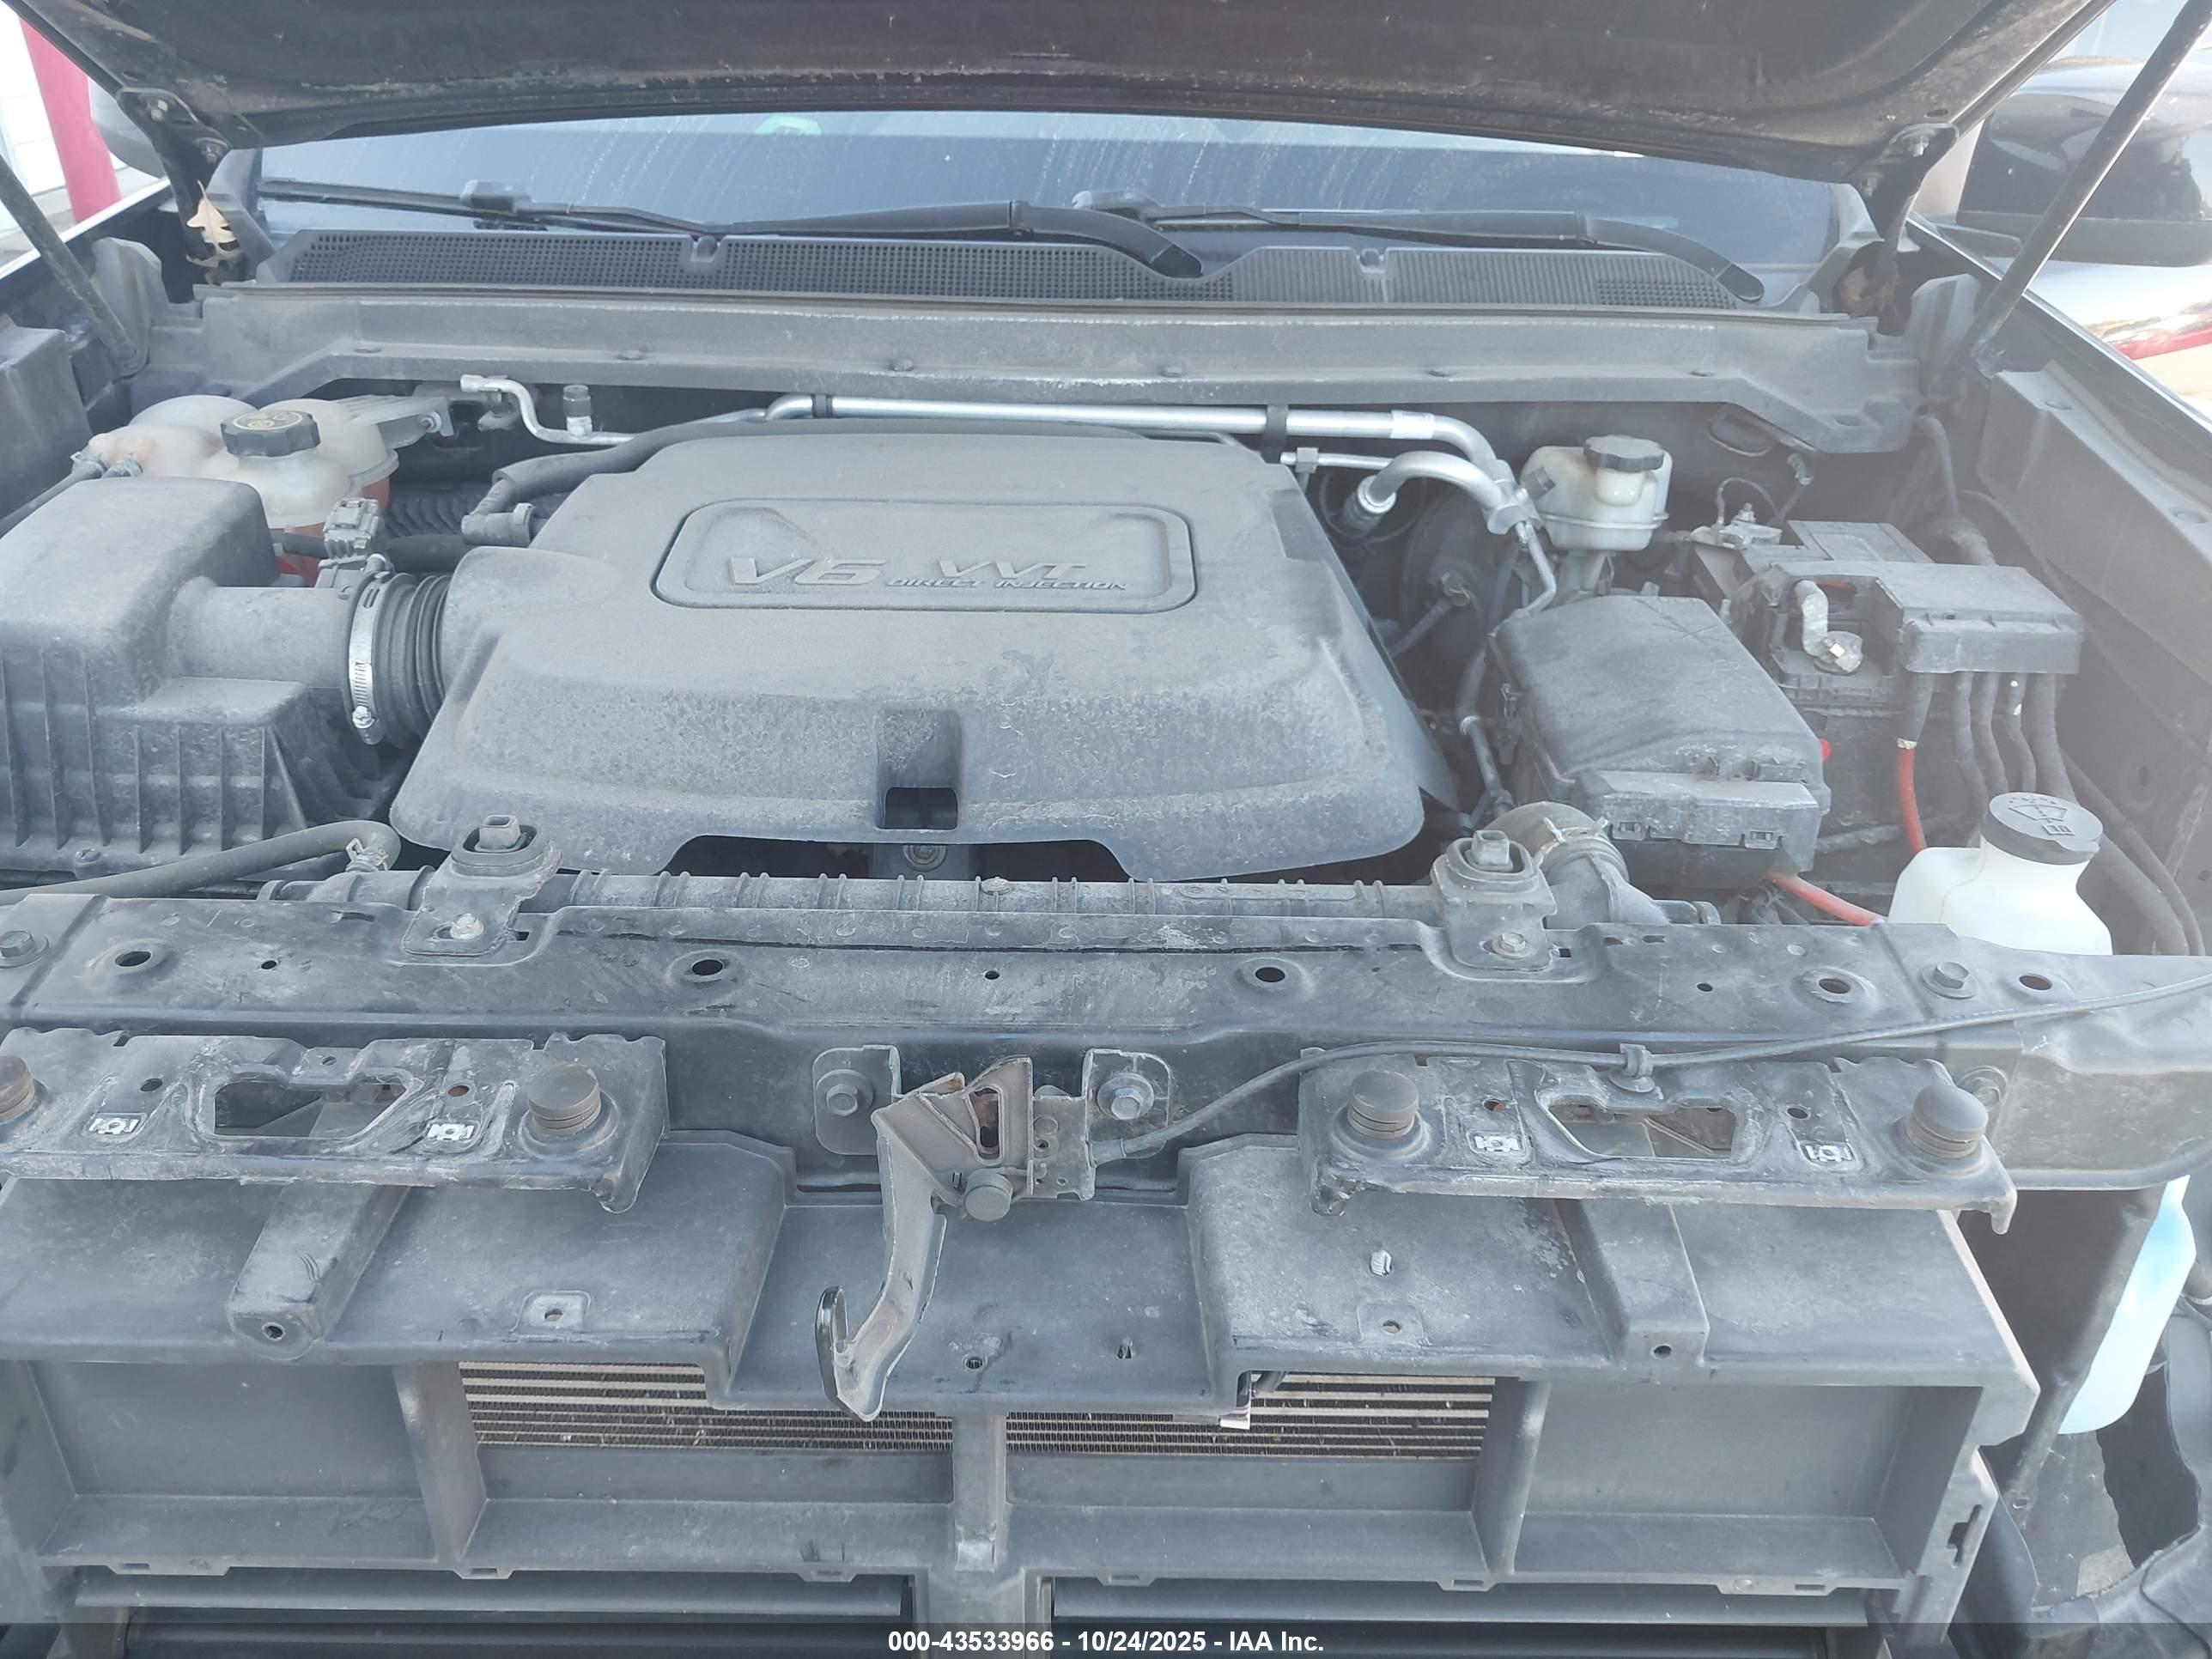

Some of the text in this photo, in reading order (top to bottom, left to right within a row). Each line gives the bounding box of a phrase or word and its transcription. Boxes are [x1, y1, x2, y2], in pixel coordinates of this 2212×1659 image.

[729, 557, 1088, 586] V6 VVT
[886, 578, 1127, 591] DIRECT INJECTION
